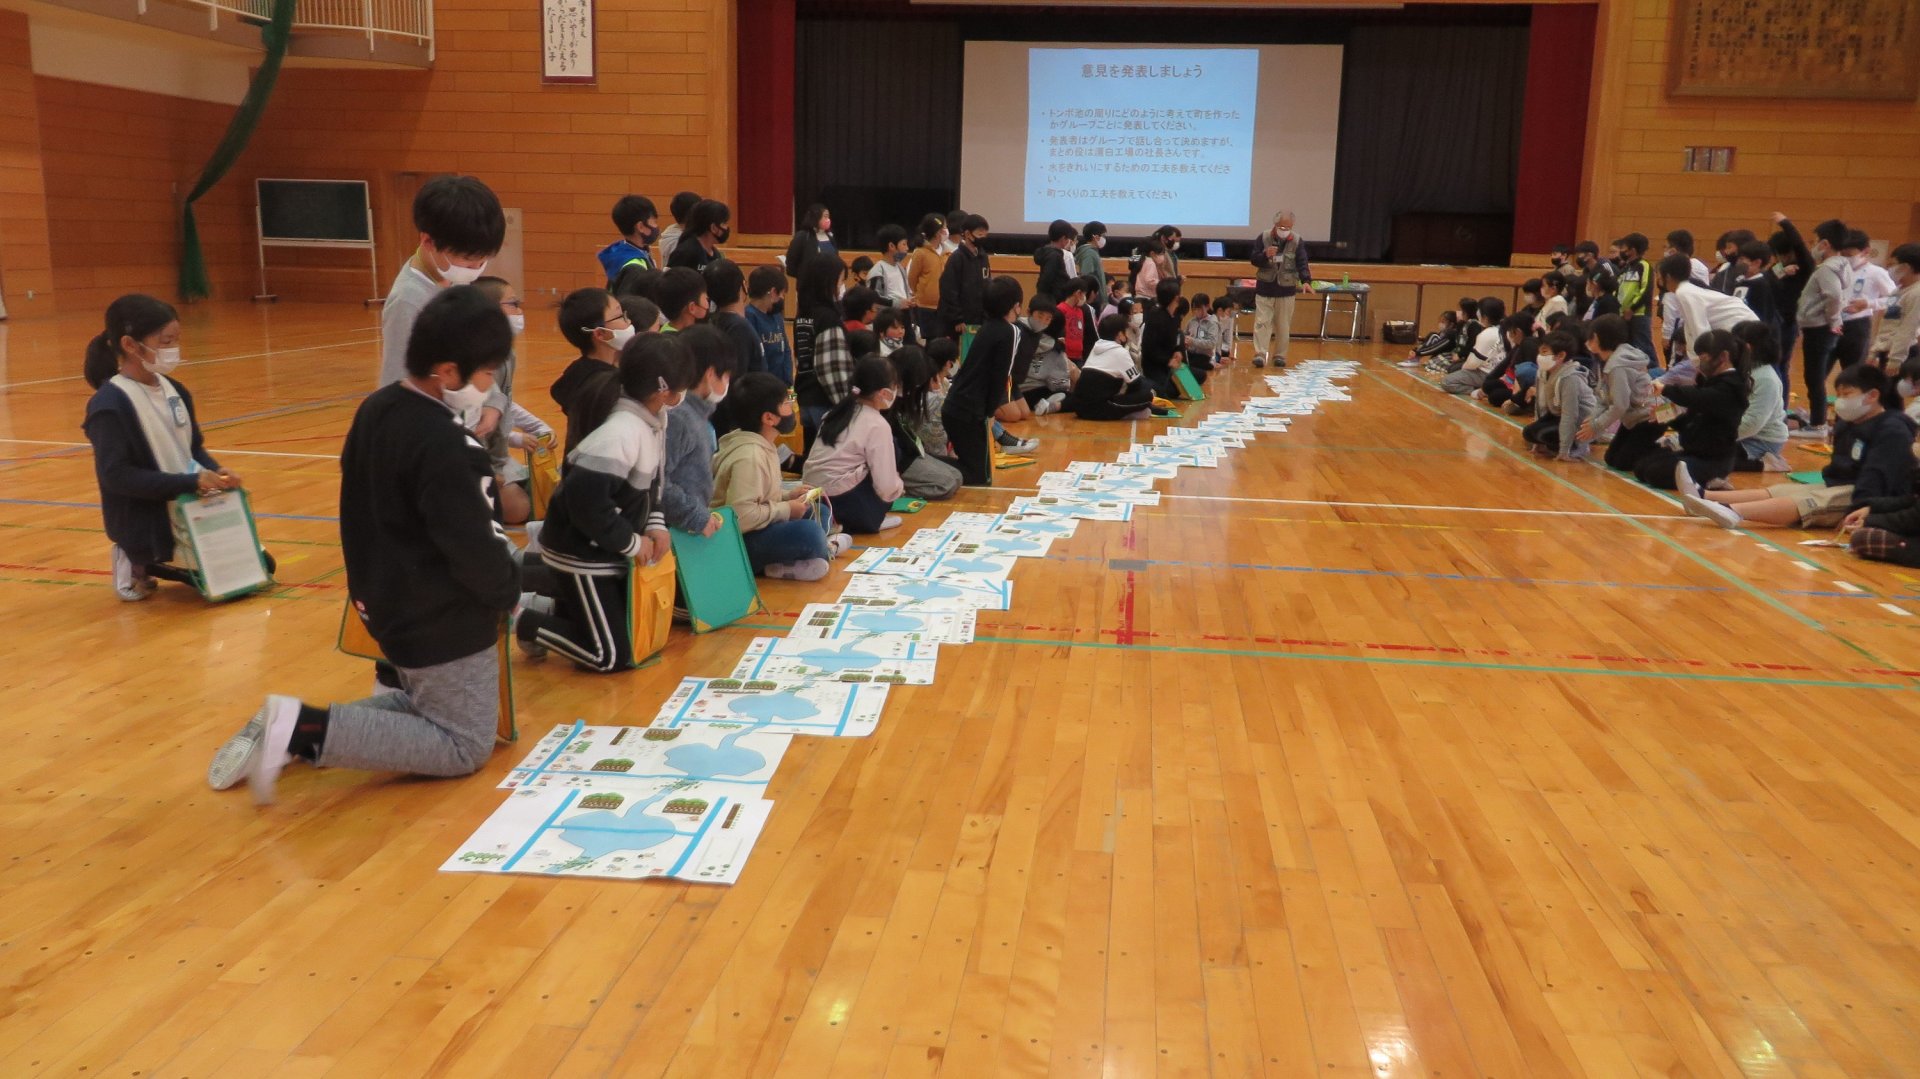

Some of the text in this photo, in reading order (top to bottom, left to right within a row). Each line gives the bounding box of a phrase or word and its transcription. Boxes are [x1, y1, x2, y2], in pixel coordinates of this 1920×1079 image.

[1081, 63, 1203, 79] 意見を発表しましょう
